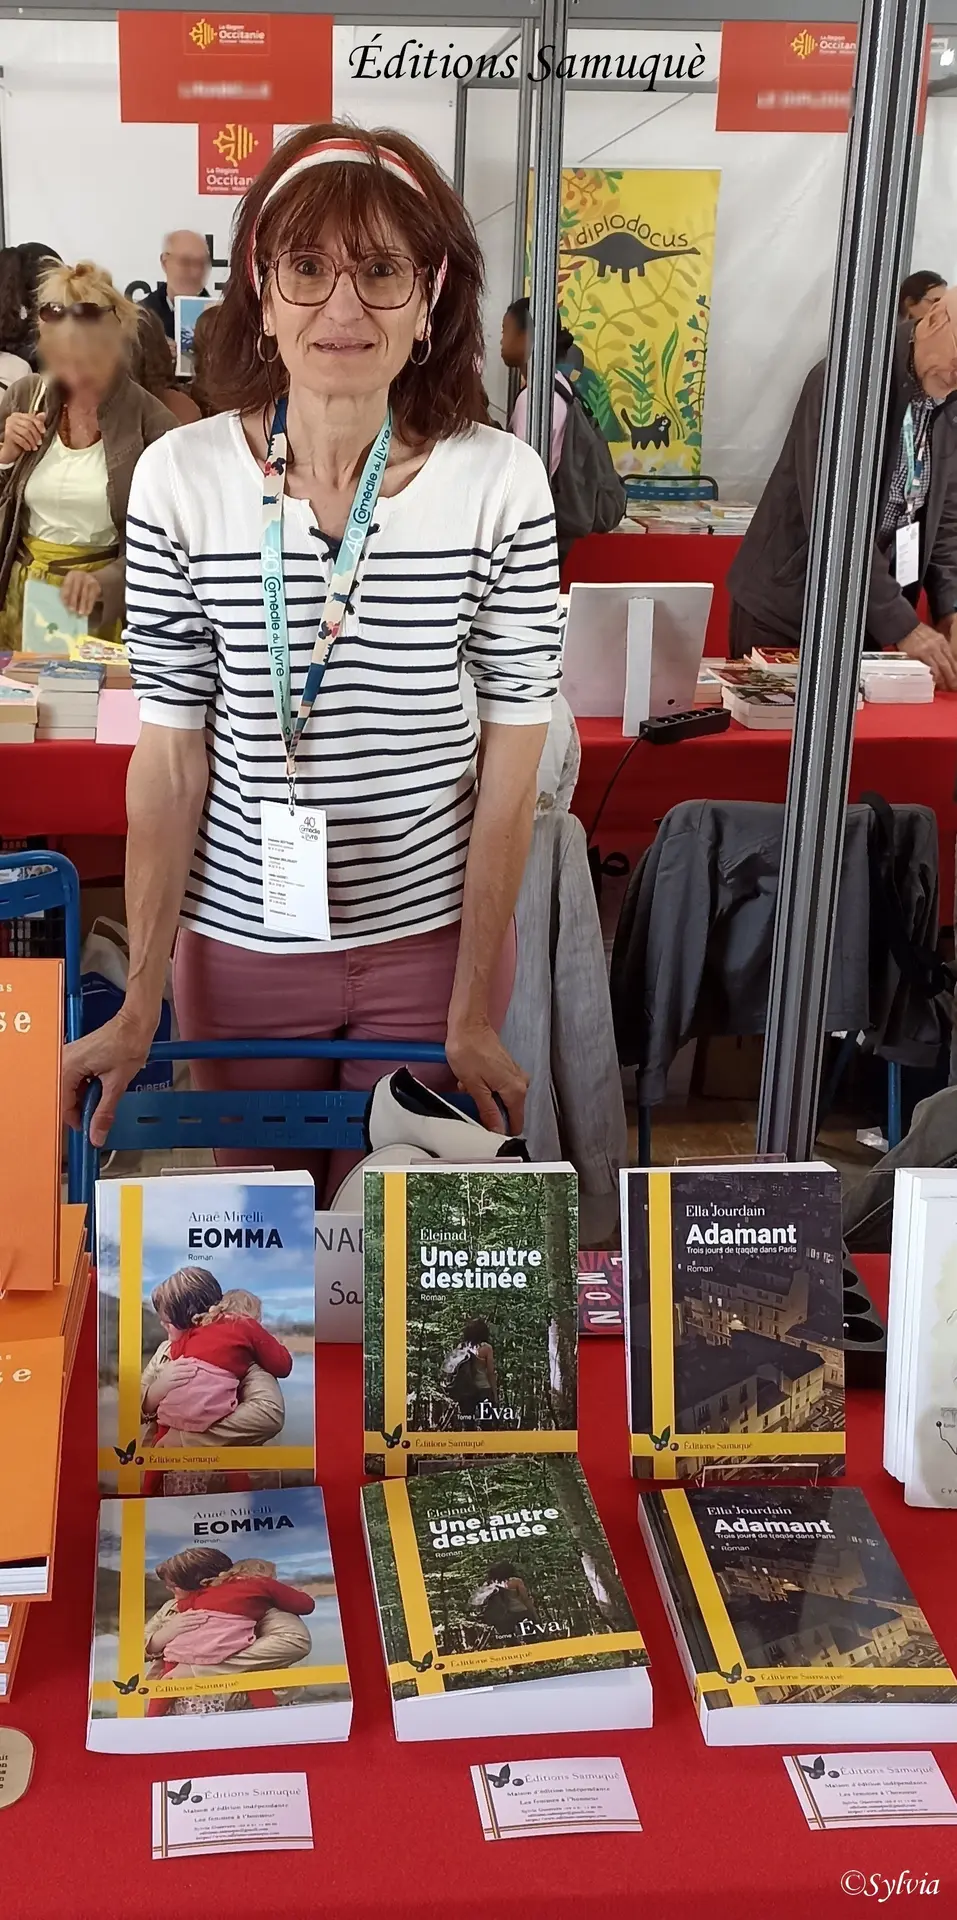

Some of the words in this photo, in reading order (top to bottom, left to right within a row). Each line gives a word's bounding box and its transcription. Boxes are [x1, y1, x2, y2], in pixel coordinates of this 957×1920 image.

[219, 30, 265, 40] Occitanie
[576, 214, 688, 247] diplodocus
[374, 430, 391, 462] Livre
[374, 462, 382, 472] du
[345, 527, 365, 555] 40
[270, 646, 285, 677] Livre
[224, 1211, 264, 1222] Mirelli
[686, 1205, 709, 1216] Ella
[711, 1204, 766, 1216] Jourdain
[188, 1228, 284, 1248] EOMMA
[686, 1223, 797, 1245] Adamant
[420, 1246, 468, 1267] Une
[476, 1246, 542, 1267] autre
[687, 1246, 704, 1254] Trois
[705, 1246, 724, 1256] jours
[724, 1246, 734, 1254] de
[760, 1246, 778, 1254] dans
[778, 1245, 797, 1253] Paris
[420, 1267, 528, 1288] destinée
[420, 1293, 446, 1301] Roman
[479, 1398, 514, 1420] Éva
[416, 1438, 446, 1448] Éditions
[684, 1440, 716, 1450] Éditions
[149, 1454, 181, 1464] Éditions
[706, 1506, 732, 1516] Ella
[735, 1506, 793, 1516] Jourdain
[194, 1515, 295, 1536] EOMMA
[430, 1518, 481, 1534] Une
[489, 1507, 560, 1526] autre
[714, 1518, 834, 1534] Adamant
[432, 1523, 548, 1550] destinée
[435, 1550, 464, 1559] Roman
[519, 1618, 562, 1637] Éva
[840, 1766, 884, 1776] Éditions
[525, 1774, 570, 1784] Éditions
[204, 1790, 250, 1800] Éditions
